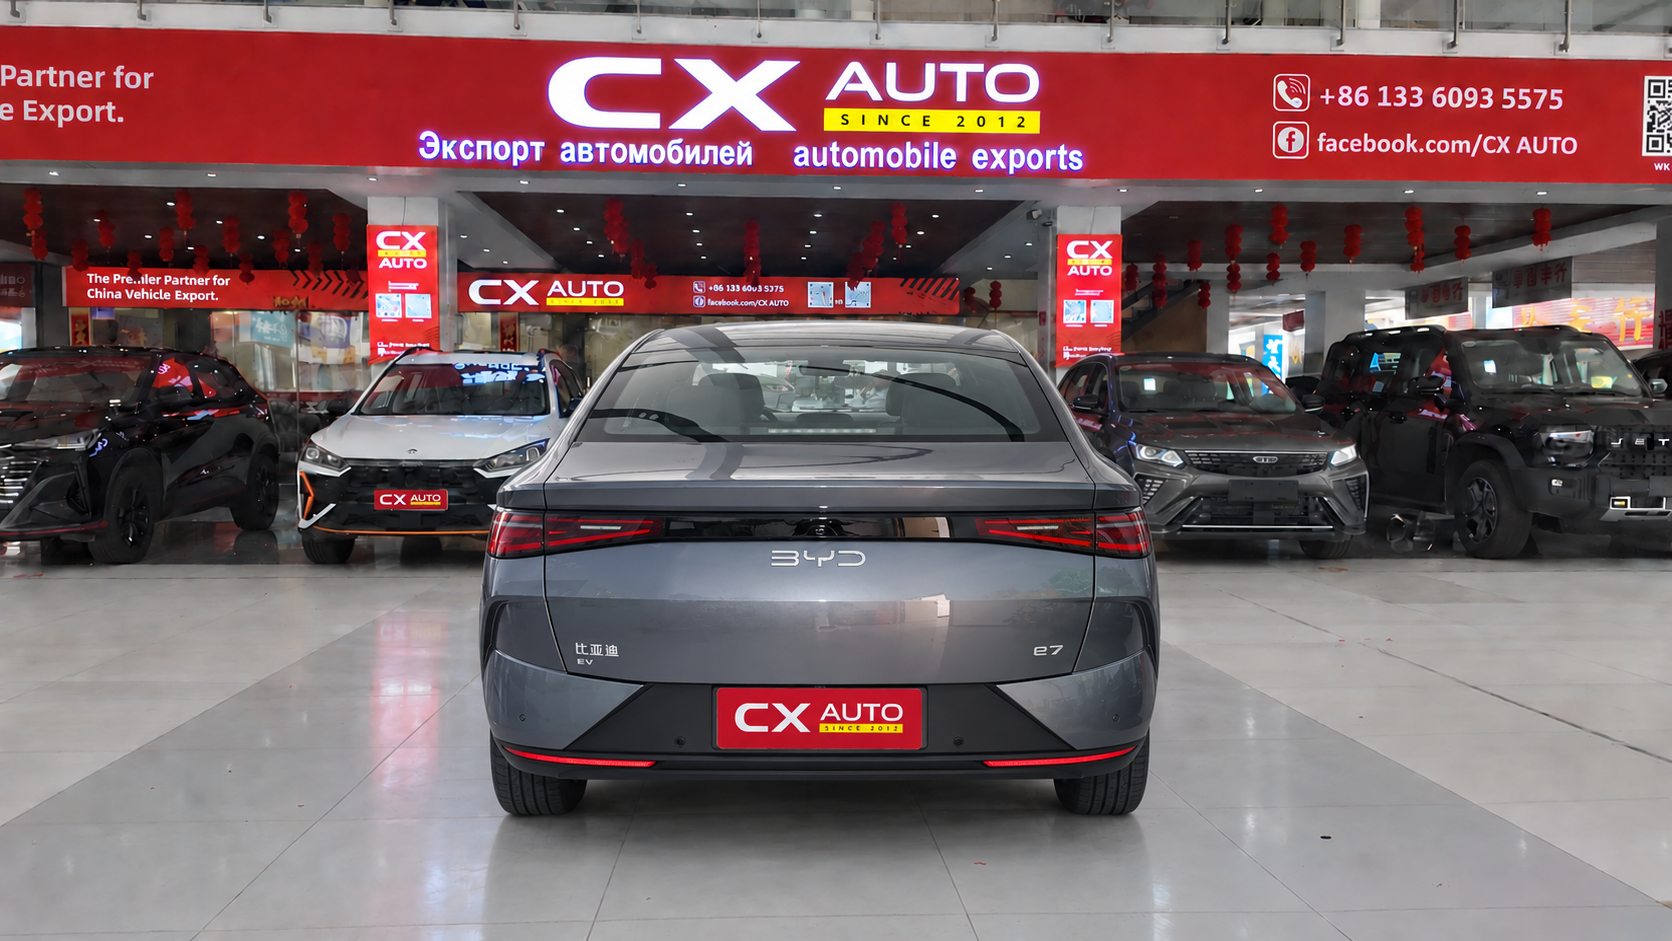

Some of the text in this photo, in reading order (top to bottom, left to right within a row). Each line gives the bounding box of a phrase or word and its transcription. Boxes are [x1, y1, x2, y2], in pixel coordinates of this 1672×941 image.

[0, 64, 155, 89] Partner for
[547, 56, 1041, 132] CX AUTO
[1319, 85, 1564, 110] +86 133 6093 5575
[23, 100, 125, 129] Export.
[840, 113, 1026, 129] SINCE 2012
[418, 130, 753, 167] Экспорт автомобилей
[1317, 133, 1579, 157] facebook.com/CX AUTO
[793, 141, 1084, 175] automobile exports
[375, 231, 427, 251] CX
[1066, 240, 1114, 259] CX
[378, 257, 428, 269] AUTO
[1067, 265, 1113, 276] AUTO
[86, 273, 110, 284] The
[164, 275, 209, 286] Partner
[212, 274, 231, 286] for
[86, 288, 219, 303] China Vehicle Export.
[468, 279, 625, 306] CX AUTO
[768, 299, 789, 307] AUTO
[379, 494, 441, 506] CX AUTO
[770, 549, 867, 568] BYD
[575, 642, 620, 657] 比亚迪
[1033, 644, 1064, 656] e7
[576, 658, 594, 666] EV
[734, 702, 904, 733] CX AUTO
